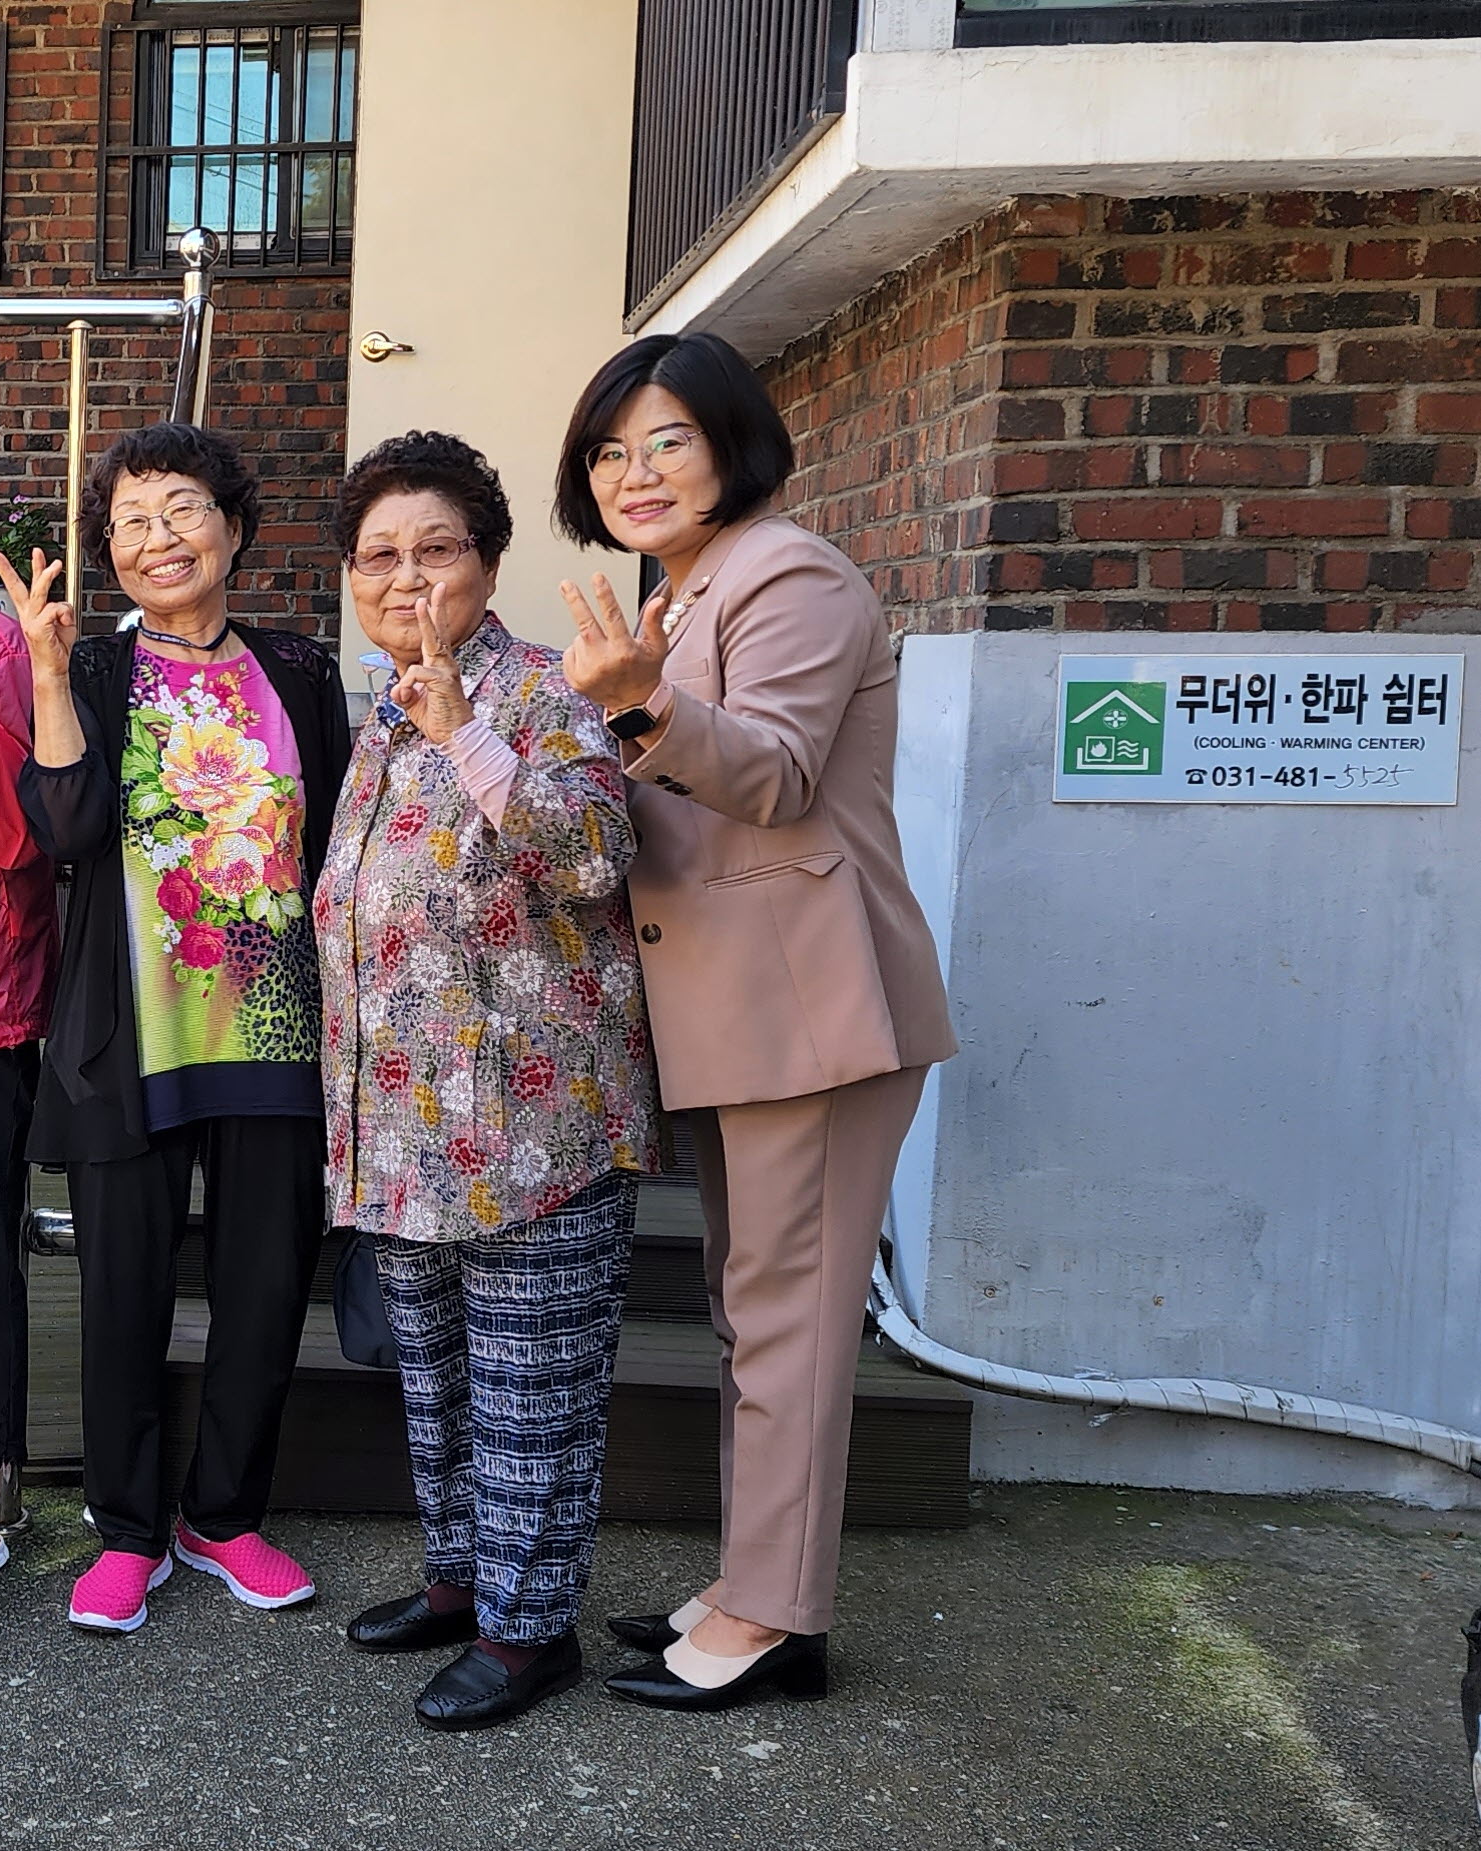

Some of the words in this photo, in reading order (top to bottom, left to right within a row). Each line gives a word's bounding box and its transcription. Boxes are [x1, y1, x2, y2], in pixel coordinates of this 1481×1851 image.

[1382, 673, 1449, 725] 쉼터
[1193, 736, 1266, 750] (COOLING
[1280, 737, 1353, 750] WARMING
[1357, 737, 1425, 751] CENTER)
